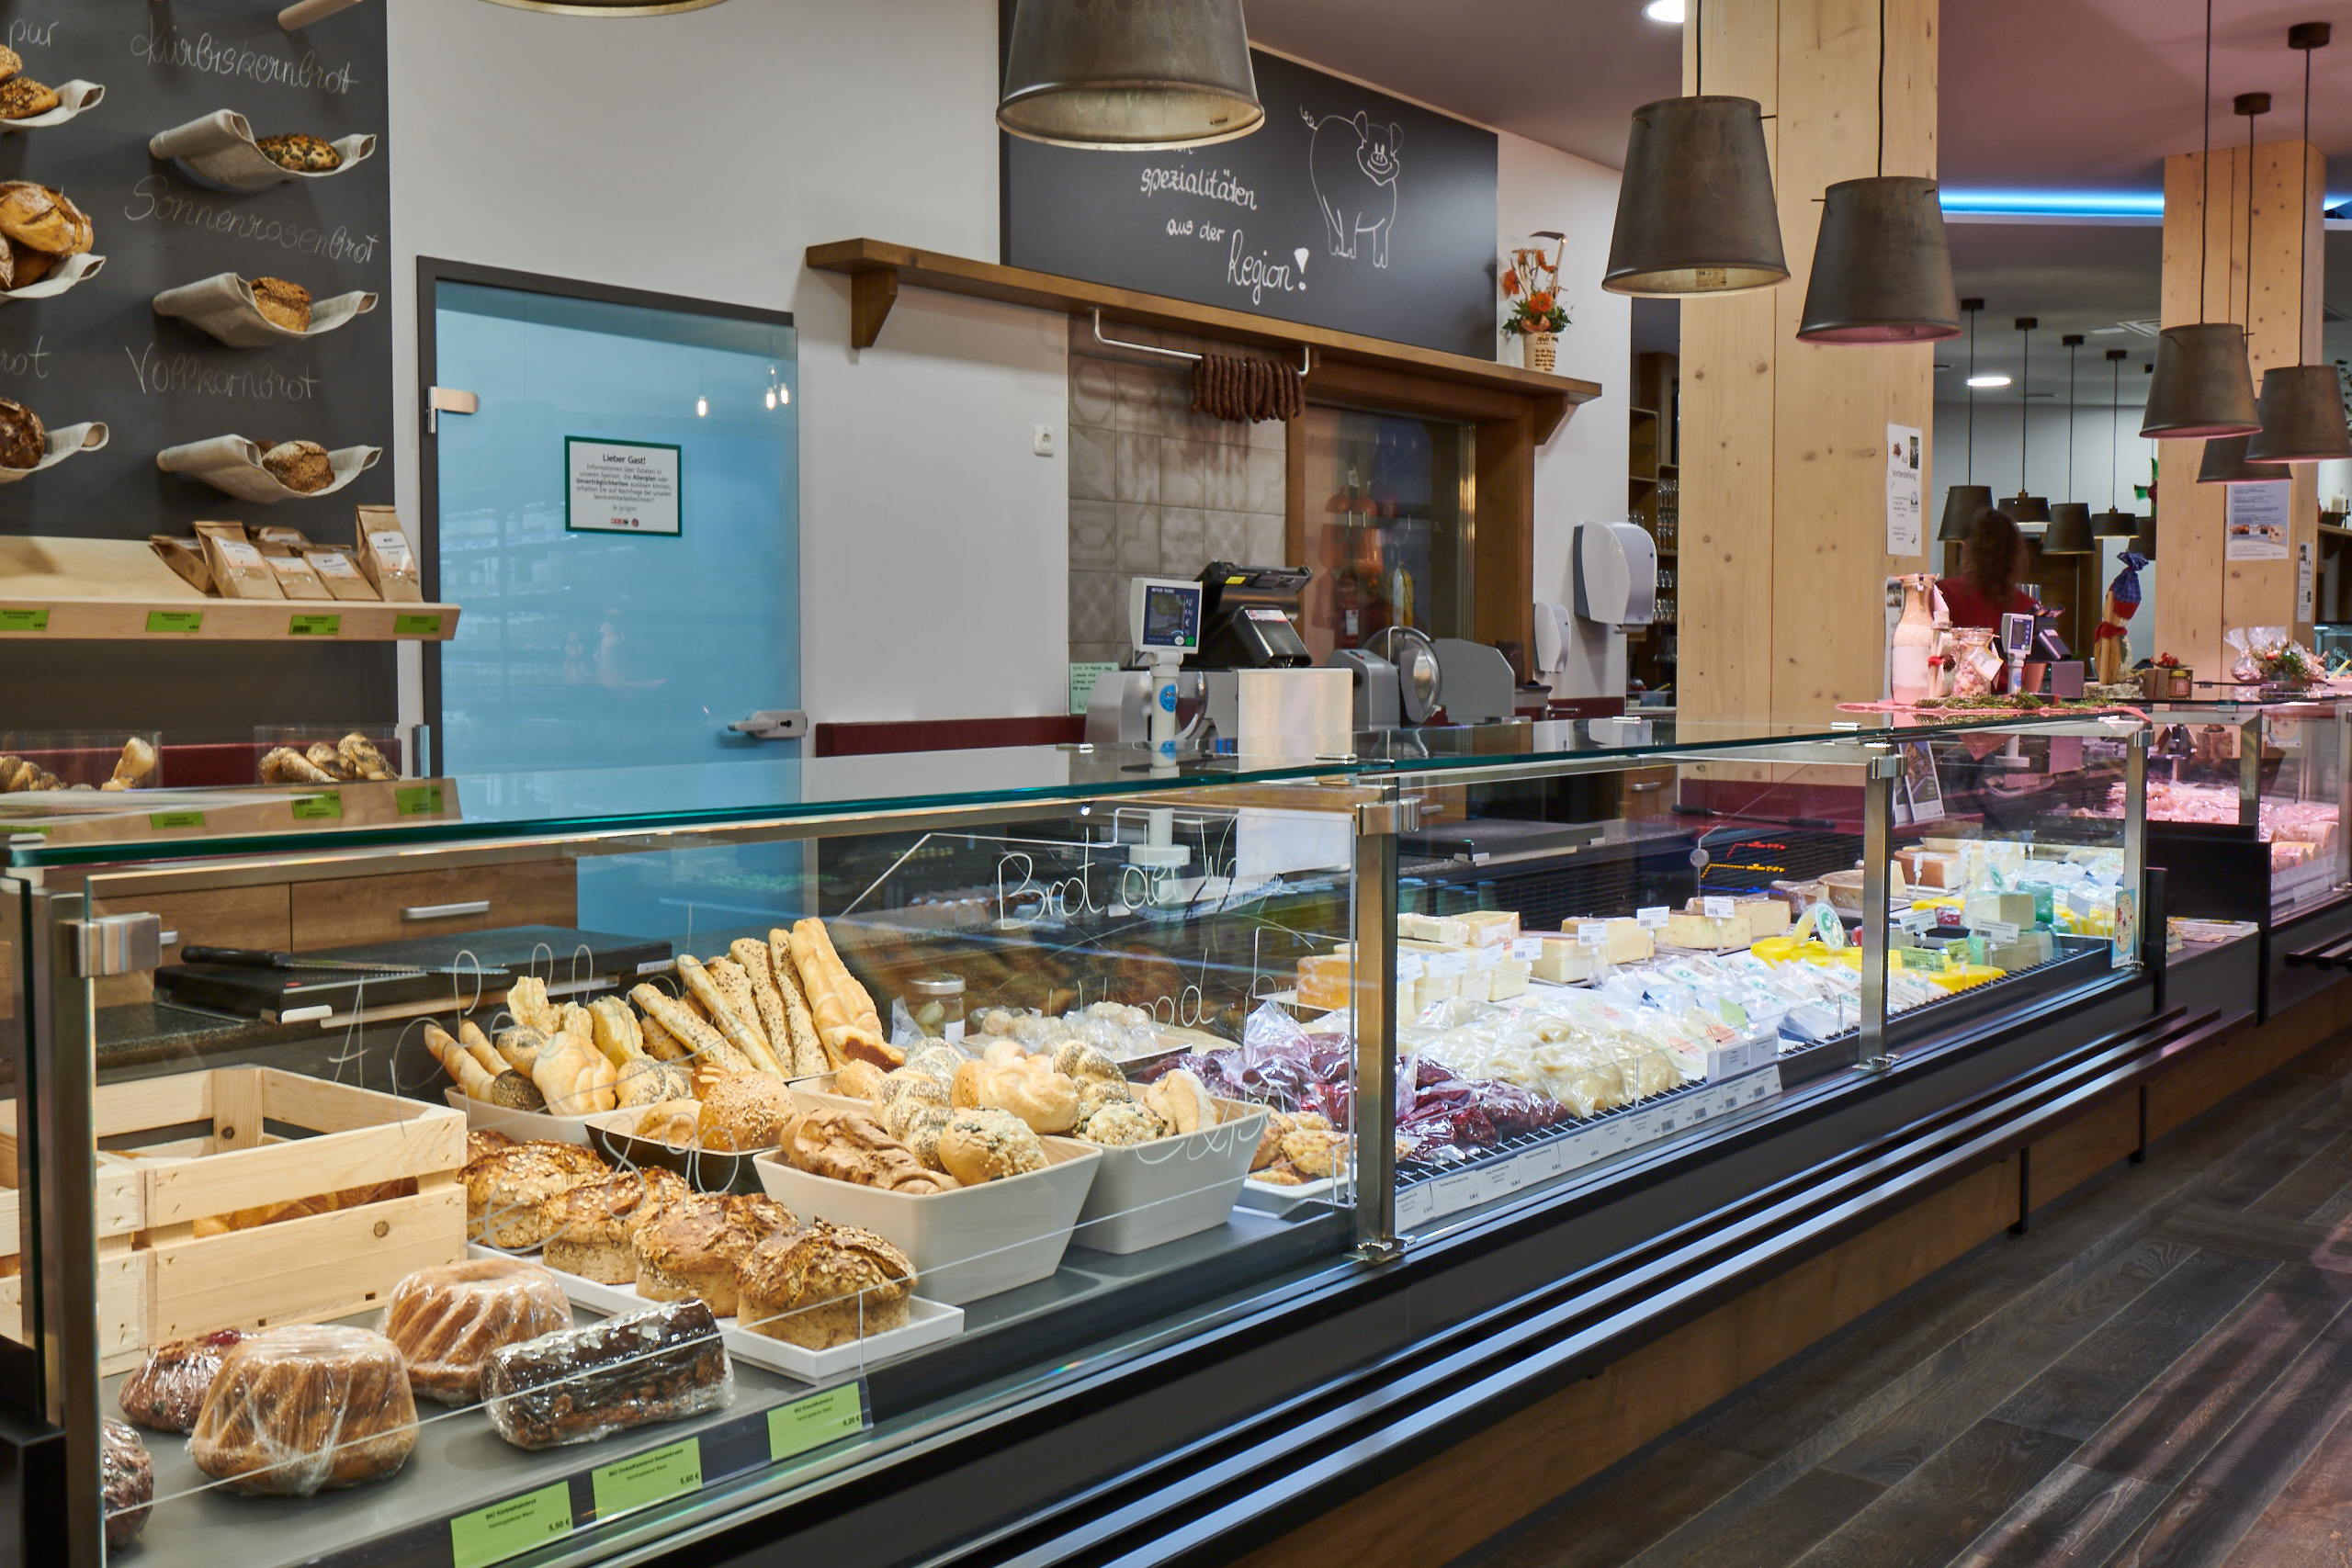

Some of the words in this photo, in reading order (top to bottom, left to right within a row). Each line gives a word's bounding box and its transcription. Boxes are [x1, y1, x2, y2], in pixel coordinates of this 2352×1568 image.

[8, 18, 60, 50] pur
[1166, 219, 1193, 236] aus
[1199, 220, 1226, 242] der
[1227, 229, 1310, 306] Region!
[125, 343, 320, 400] Vollkornbrot
[586, 463, 622, 472] Informationen
[603, 454, 626, 463] Lieber
[628, 456, 646, 465] Gast!
[576, 478, 628, 487] Unverträglichkeiten
[632, 474, 657, 482] Allergien
[998, 827, 1105, 931] Brot
[1122, 824, 1185, 910] der
